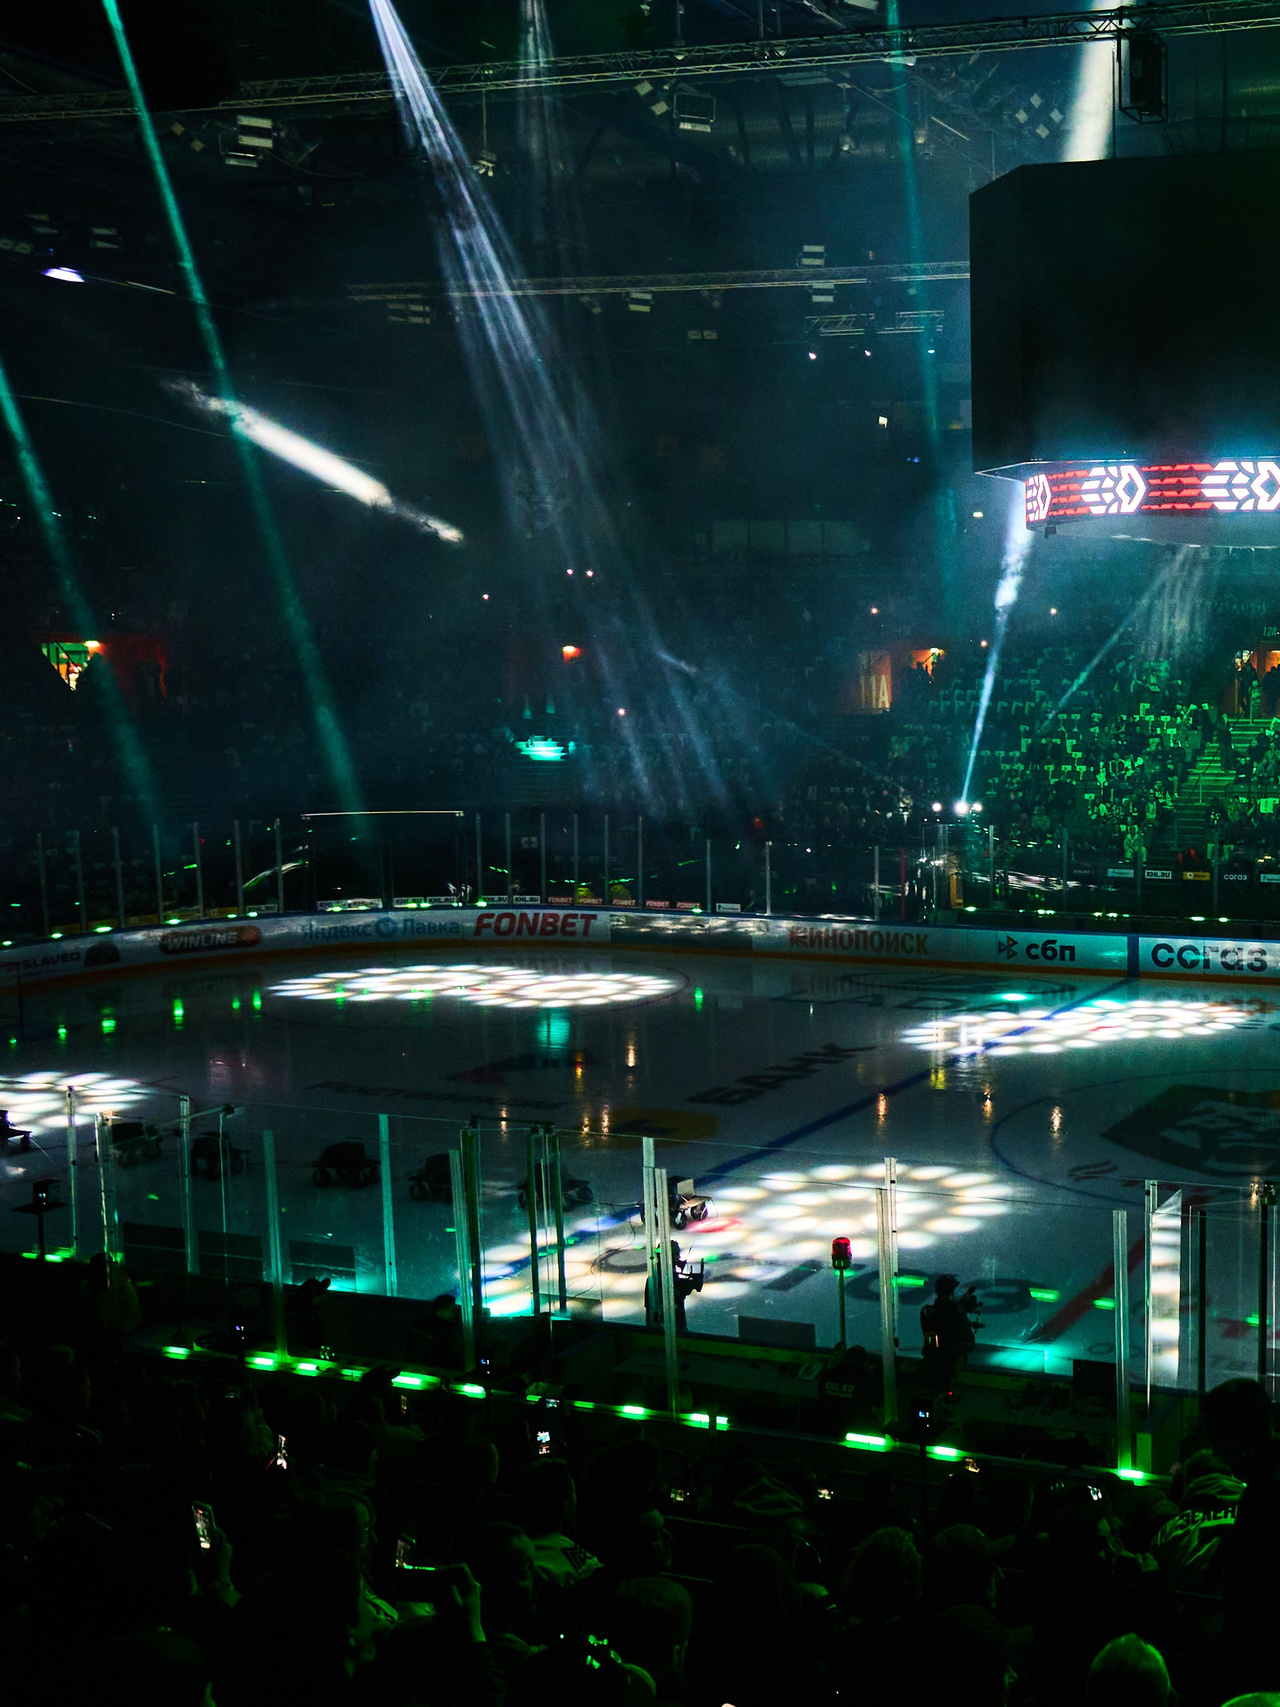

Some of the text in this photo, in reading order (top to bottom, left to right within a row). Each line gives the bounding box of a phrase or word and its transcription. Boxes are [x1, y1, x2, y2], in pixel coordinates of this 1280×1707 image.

[1223, 873, 1248, 881] согаз
[402, 917, 460, 936] Лавка
[473, 912, 598, 937] FONBET
[166, 932, 238, 951] WINLINE
[1025, 939, 1076, 962] сбп
[1151, 943, 1268, 972] согаз
